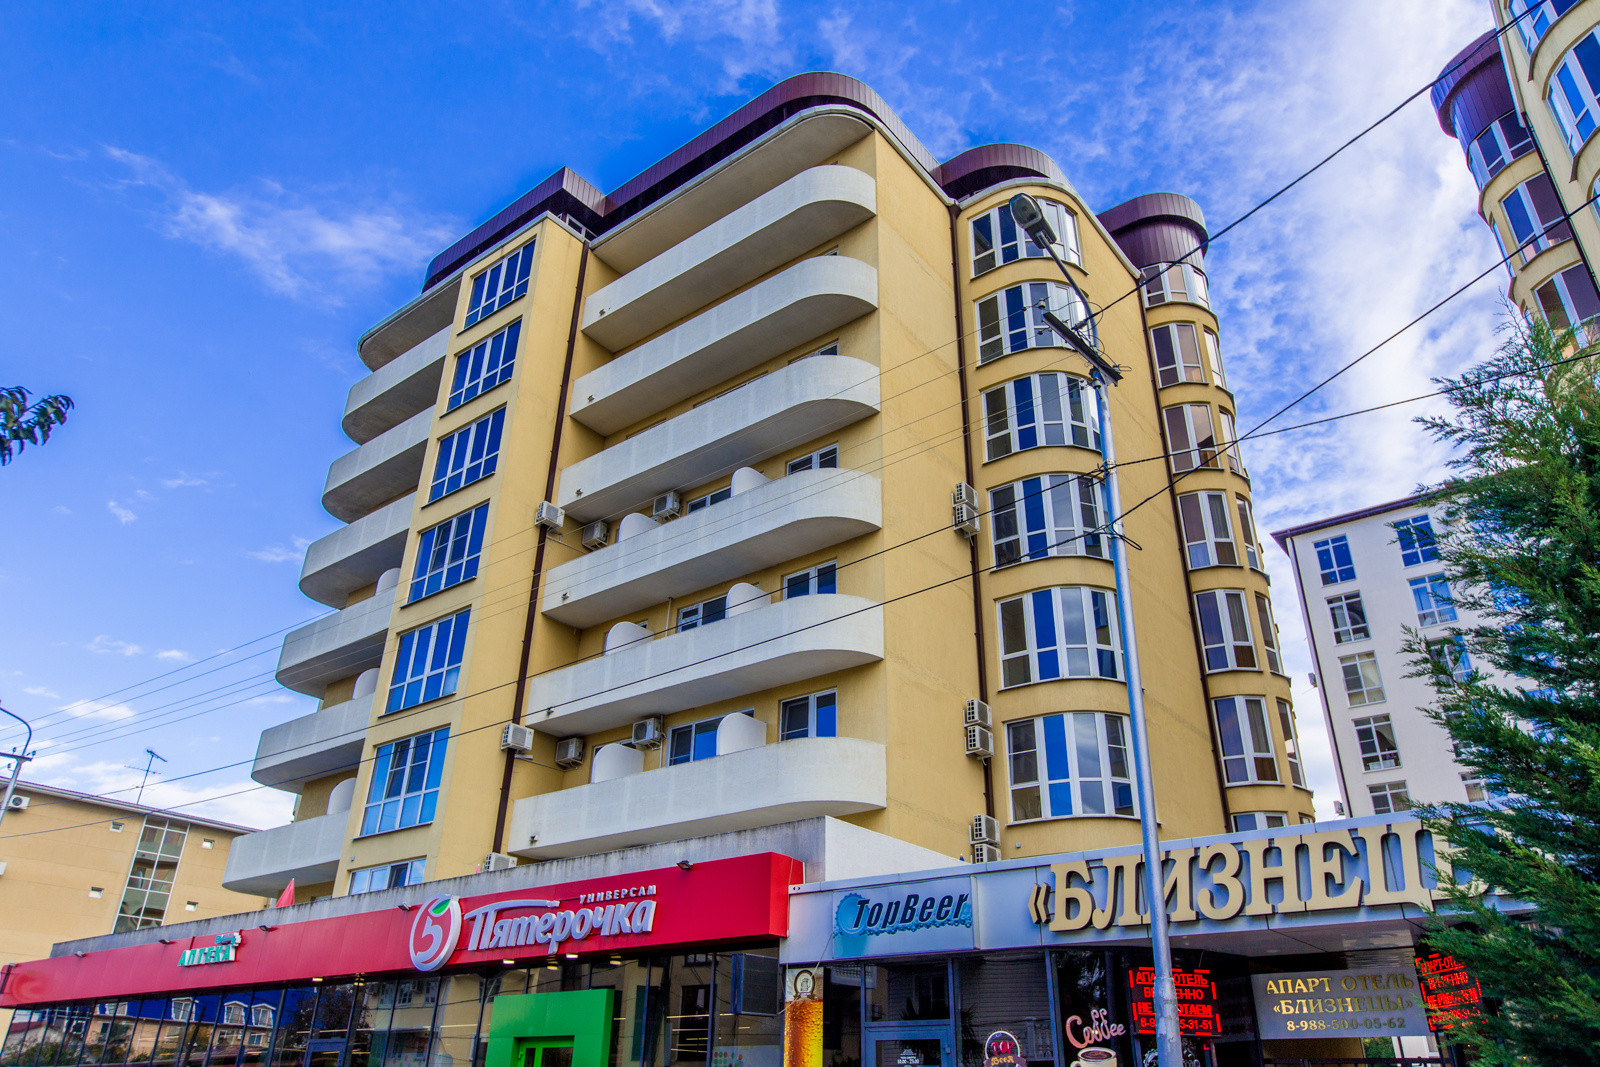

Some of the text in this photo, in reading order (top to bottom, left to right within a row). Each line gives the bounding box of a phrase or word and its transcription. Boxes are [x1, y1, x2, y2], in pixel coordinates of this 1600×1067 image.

[579, 885, 657, 904] УНИВЕРСАМ
[464, 899, 657, 954] Пятерочка
[177, 944, 236, 967] АПТЕКА
[1266, 973, 1414, 994] АПАРТ ОТЕЛЬ
[1137, 1002, 1153, 1013] НЕ
[1273, 996, 1413, 1015] «БЛИЗНЕЦЫ»
[1066, 1008, 1126, 1048] Coffee
[1286, 1017, 1406, 1031] 8-988-500-05-62
[991, 1041, 1015, 1055] TOP
